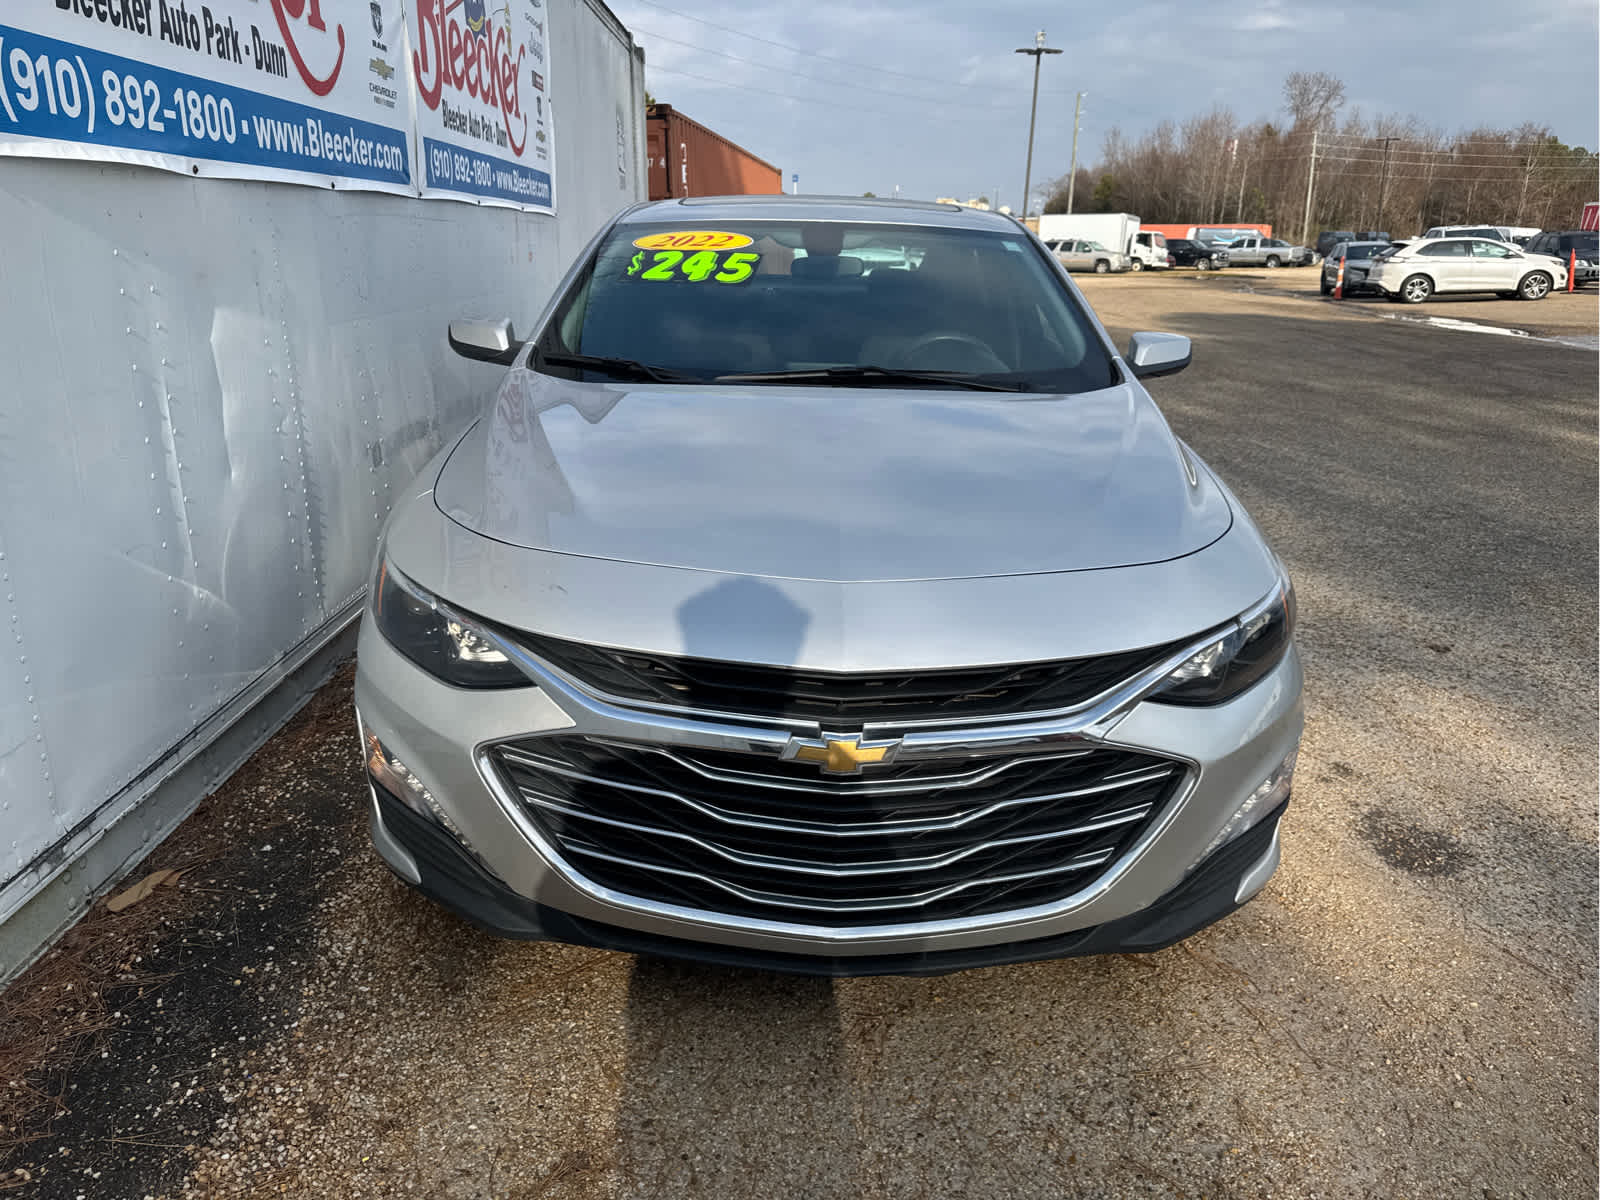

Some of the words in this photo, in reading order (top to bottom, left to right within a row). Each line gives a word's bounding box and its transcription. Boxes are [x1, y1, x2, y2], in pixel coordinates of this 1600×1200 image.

[56, 0, 152, 37] ecker
[160, 0, 201, 52] Auto
[202, 5, 242, 64] Park
[251, 25, 288, 78] Dunn
[0, 36, 95, 133] (910)
[102, 69, 237, 144] 892-1800
[252, 115, 404, 171] www.Bleecker.com
[369, 82, 397, 99] CHEVROLET
[441, 98, 468, 136] Bleecker
[468, 109, 481, 140] Auto
[481, 115, 493, 143] Park
[430, 143, 454, 185] (910)
[454, 153, 492, 187] 892-1800
[496, 169, 549, 201] www.Bleecker.com
[650, 235, 734, 247] 2022
[627, 250, 760, 283] $245
